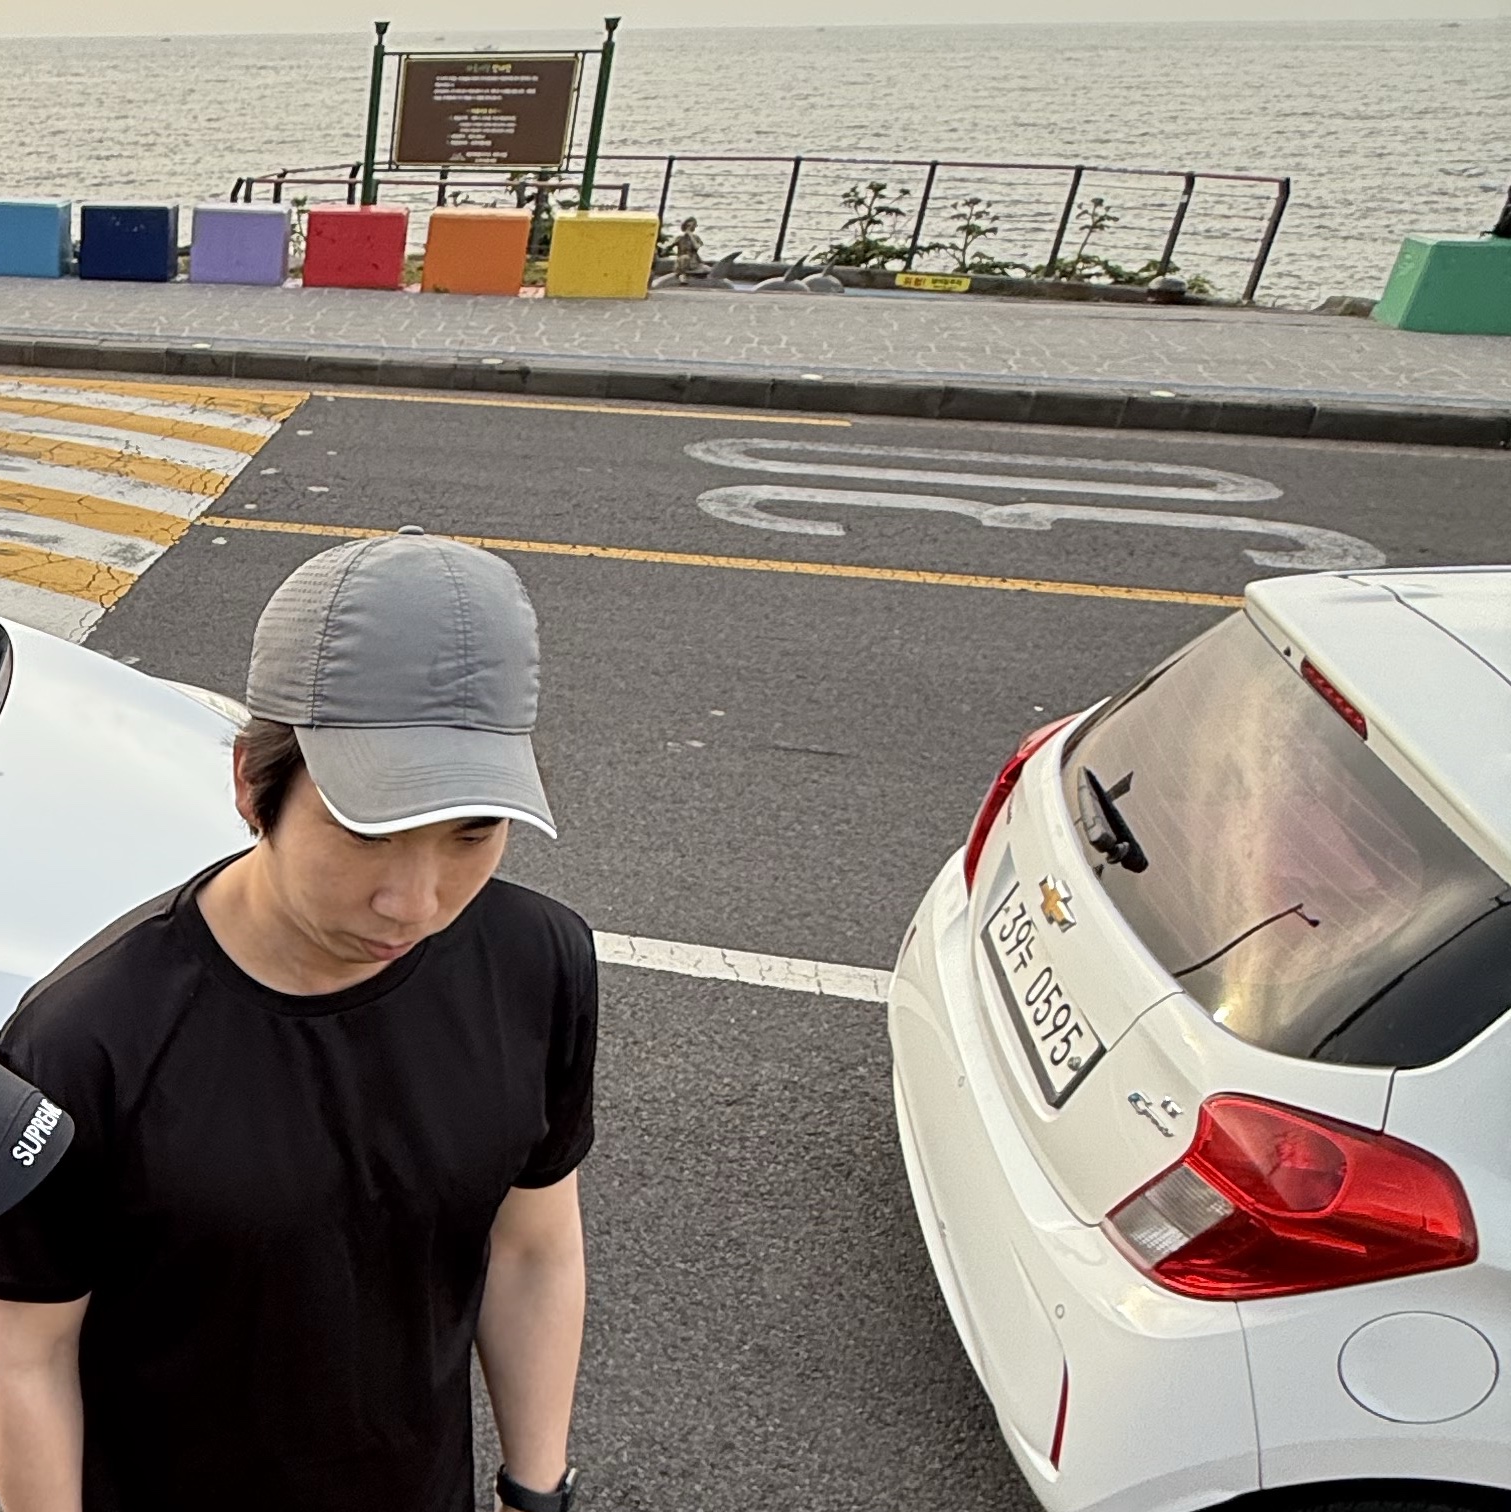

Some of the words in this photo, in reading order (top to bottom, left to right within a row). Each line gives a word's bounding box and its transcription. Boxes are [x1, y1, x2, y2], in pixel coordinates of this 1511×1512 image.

[683, 437, 1386, 570] 30
[999, 902, 1035, 973] 39누
[1025, 966, 1084, 1066] 0595
